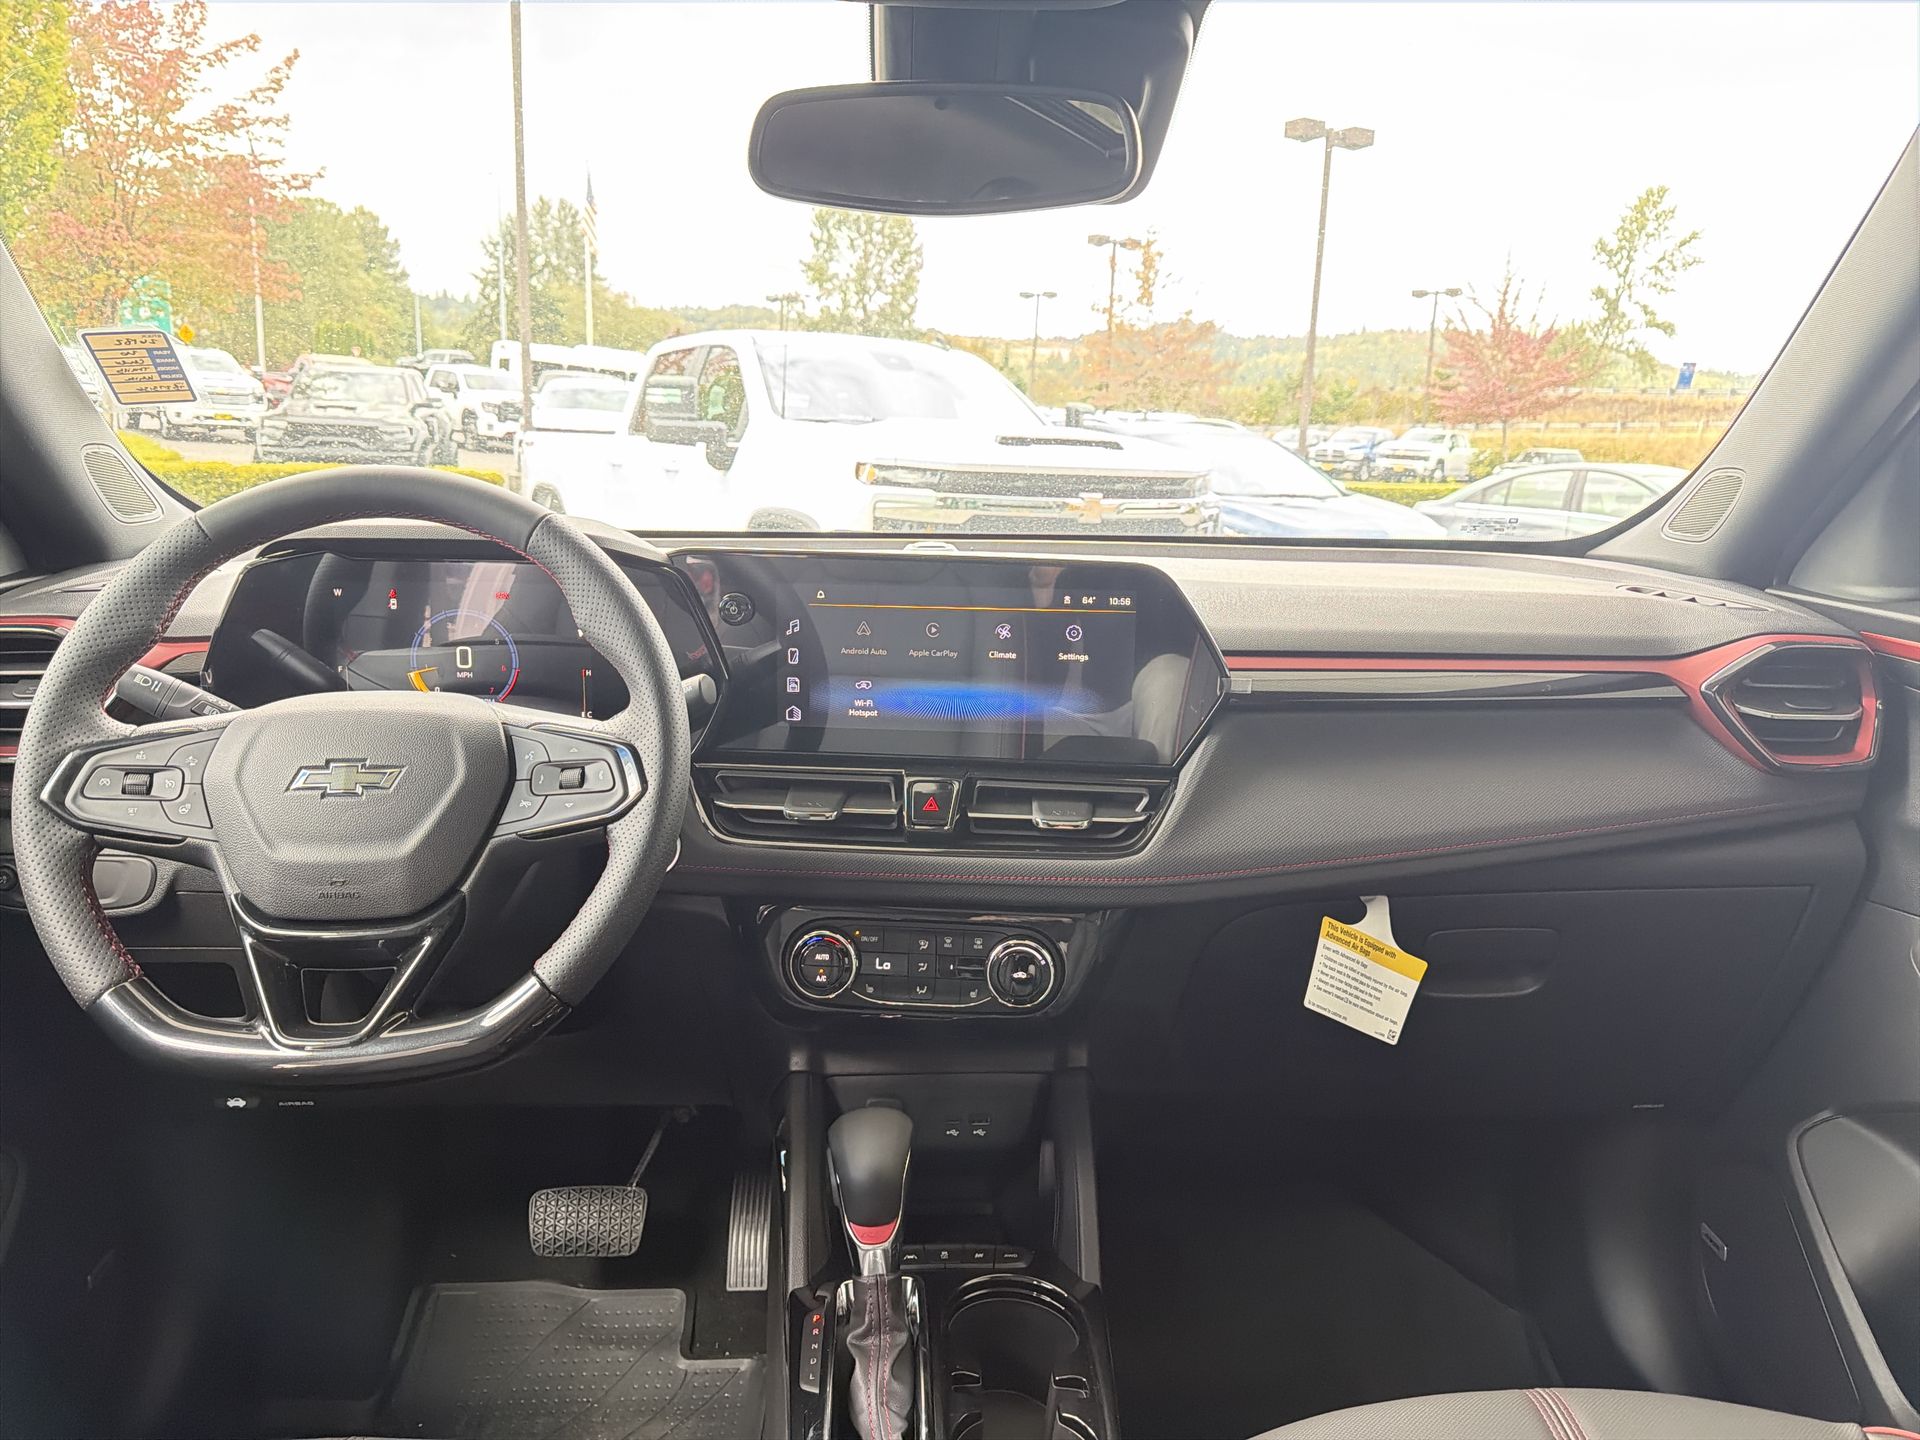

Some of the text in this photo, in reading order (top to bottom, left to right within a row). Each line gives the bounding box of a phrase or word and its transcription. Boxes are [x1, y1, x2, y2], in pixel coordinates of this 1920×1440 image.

[333, 588, 342, 596] W
[841, 648, 887, 656] Android Auto
[909, 649, 958, 659] Apple CarPlay
[989, 651, 1017, 659] Climate
[456, 646, 472, 668] 0
[1058, 653, 1088, 662] Settings
[456, 671, 473, 679] MPH
[854, 699, 873, 707] Wi-Fi
[587, 711, 593, 719] C
[848, 709, 878, 718] Hotspot
[318, 891, 360, 900] AIRBAG
[1325, 930, 1371, 958] Advanced Air Bags
[1327, 921, 1339, 932] This
[1339, 926, 1358, 941] Vehicle
[1363, 939, 1385, 954] Equipped
[1384, 948, 1397, 959] with
[815, 953, 830, 961] AUTO
[875, 957, 891, 970] Lo
[813, 1314, 820, 1323] P
